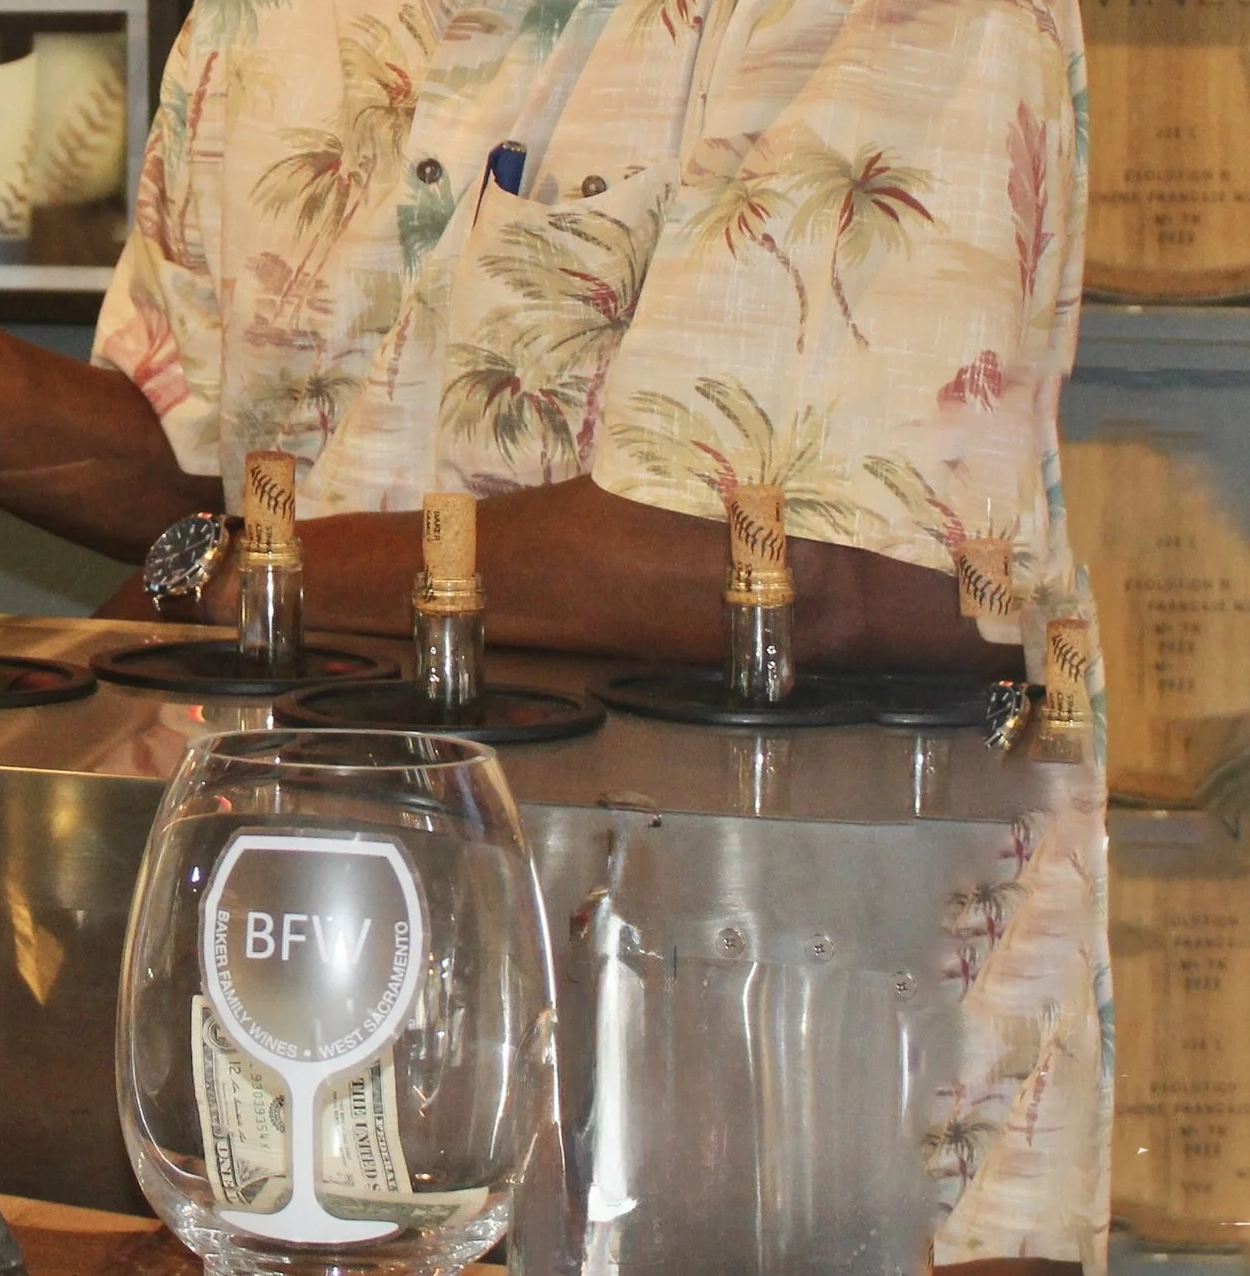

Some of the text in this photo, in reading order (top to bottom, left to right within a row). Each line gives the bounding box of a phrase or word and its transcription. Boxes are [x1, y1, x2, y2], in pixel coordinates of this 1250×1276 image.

[214, 910, 409, 1059] BAKER FAMILY WINES WEST SACRAMENTO
[245, 911, 372, 965] BFW
[351, 1077, 379, 1180] THE UNITED
